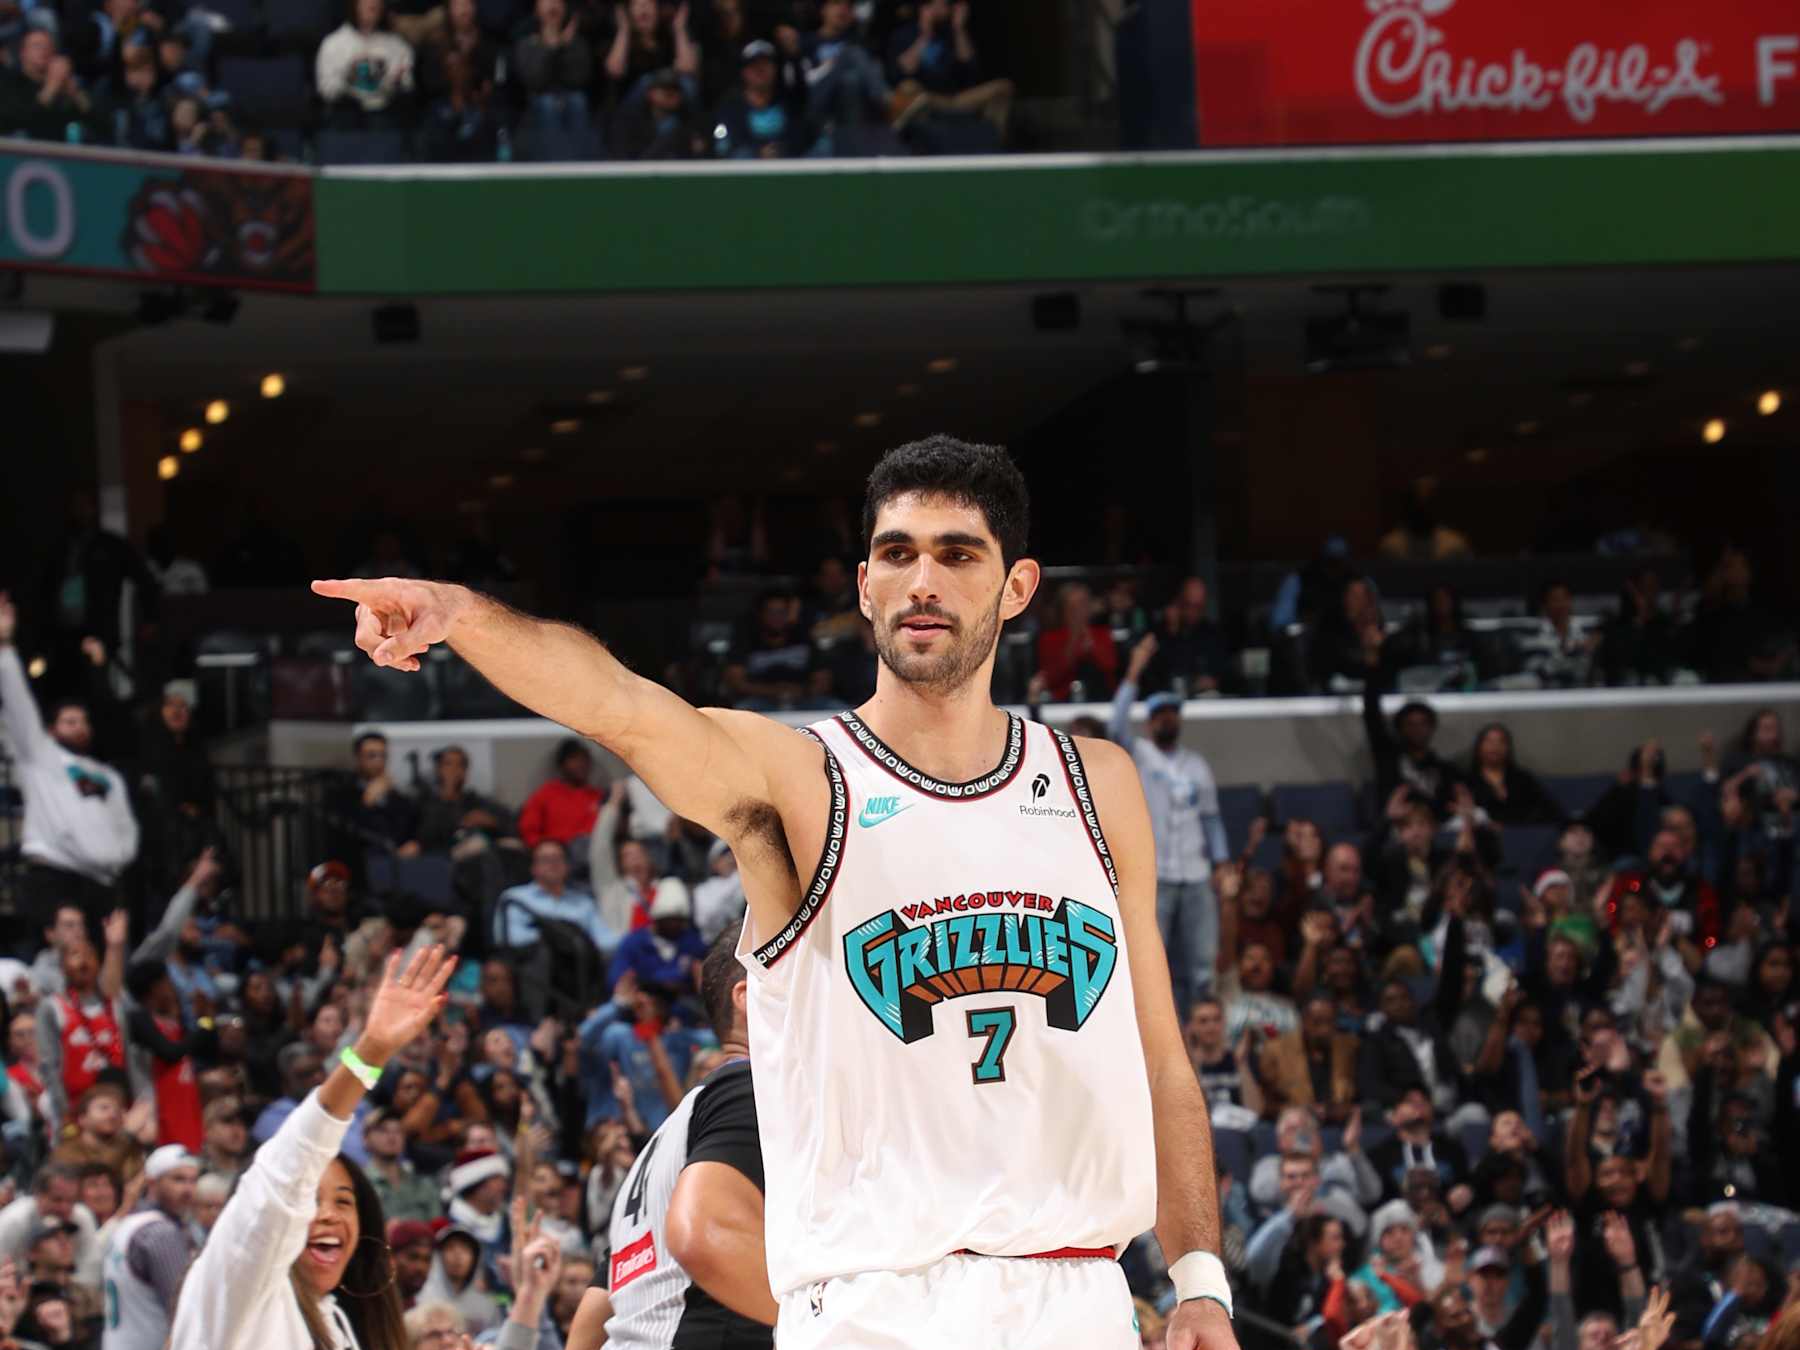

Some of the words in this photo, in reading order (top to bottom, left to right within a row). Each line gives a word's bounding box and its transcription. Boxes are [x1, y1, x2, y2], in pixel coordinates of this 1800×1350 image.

[865, 796, 900, 815] NIKE
[1019, 804, 1076, 818] Robinhood
[900, 890, 1054, 921] VANCOUVER
[842, 896, 1118, 1044] GRIZZLIES
[965, 1005, 1017, 1085] 7
[615, 1245, 655, 1283] Emirates
